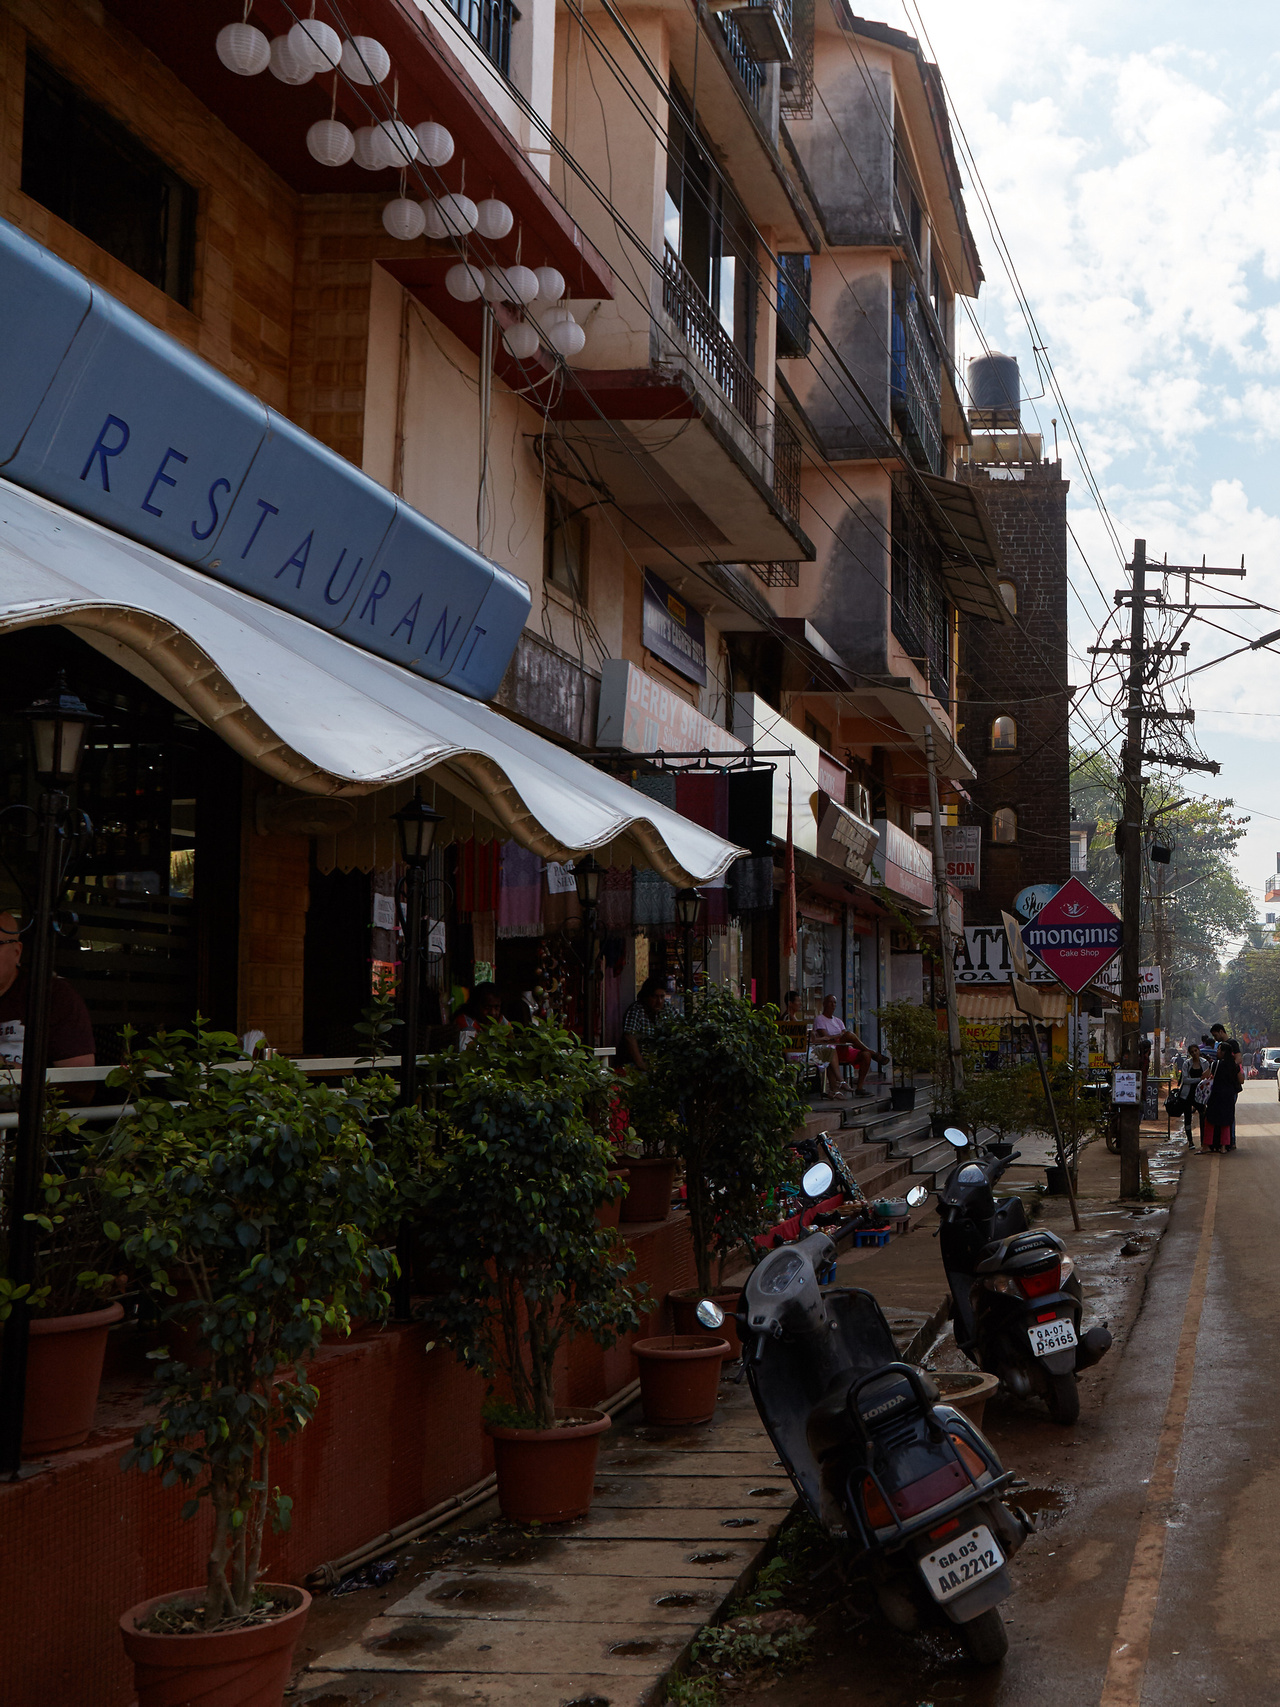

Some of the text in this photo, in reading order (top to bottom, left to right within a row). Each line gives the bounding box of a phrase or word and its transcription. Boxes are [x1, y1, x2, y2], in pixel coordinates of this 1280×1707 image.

[80, 413, 488, 671] RESTAURANT
[630, 669, 678, 728] DERBY
[680, 704, 718, 747] SHIRE
[1060, 949, 1099, 958] Cake Shop
[1014, 1241, 1045, 1253] HONDA
[938, 1540, 978, 1569] GA.03
[938, 1549, 998, 1594] AA.2212
